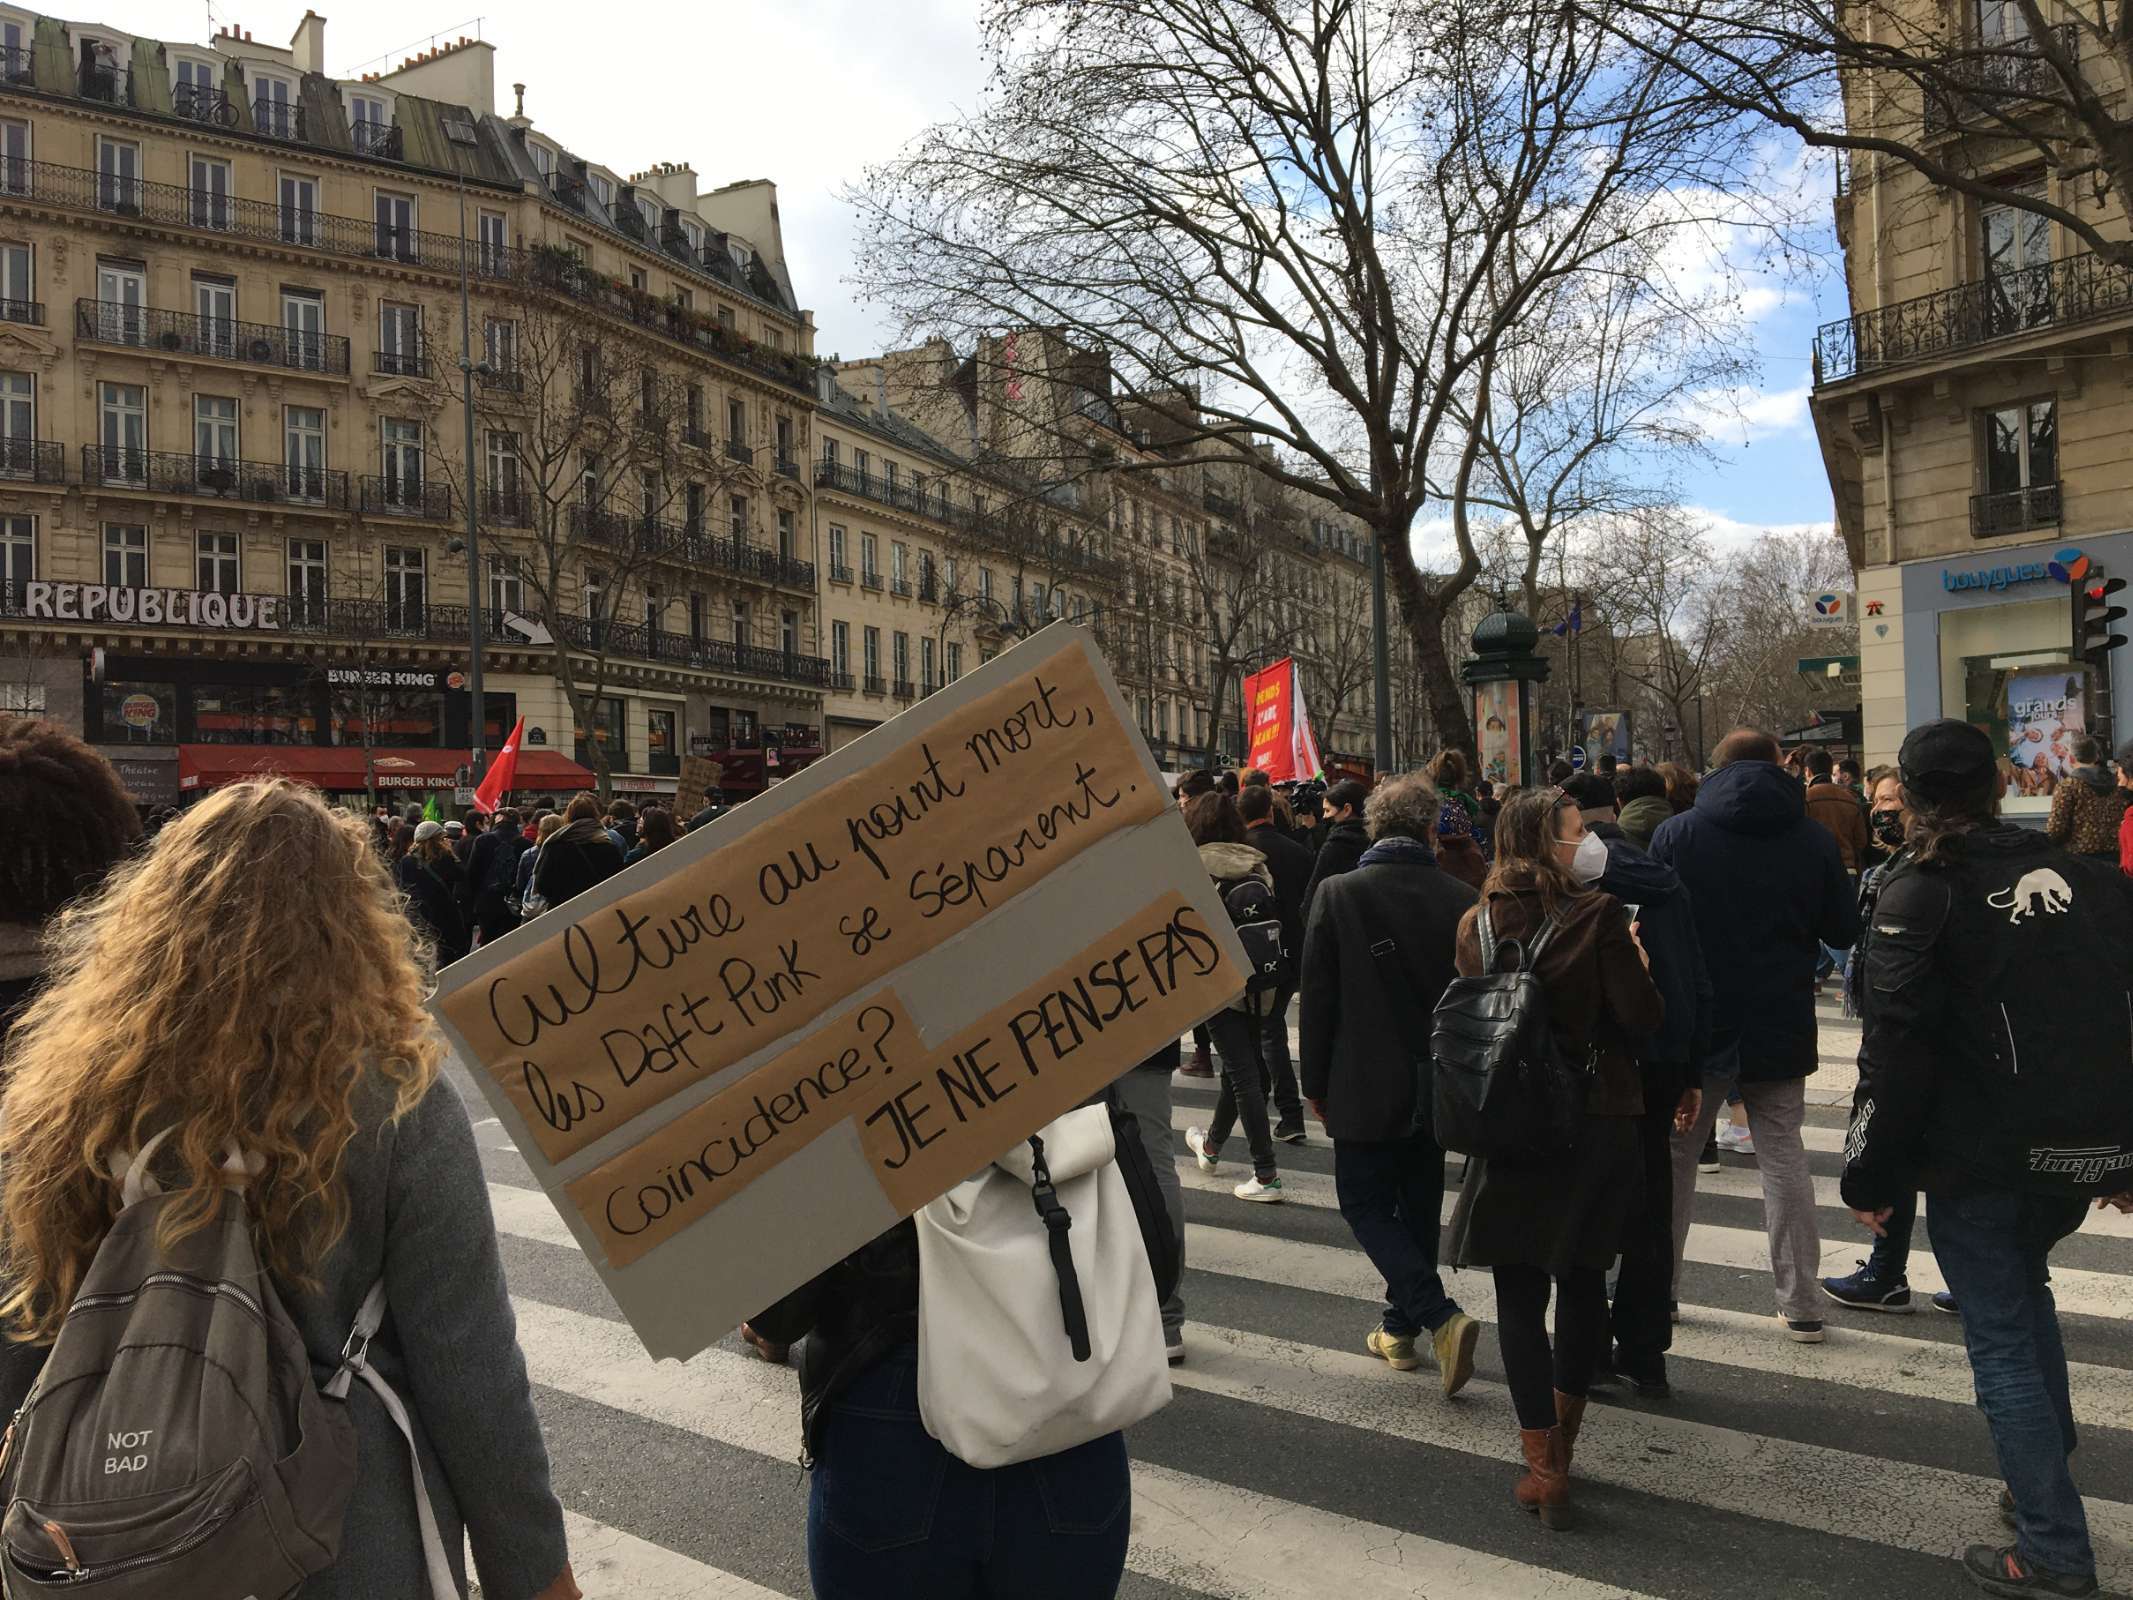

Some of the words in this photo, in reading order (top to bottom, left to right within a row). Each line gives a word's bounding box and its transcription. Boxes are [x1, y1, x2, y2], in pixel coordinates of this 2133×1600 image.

[1942, 562, 2046, 592] bouygues
[26, 581, 280, 629] REPUBLIQUE
[328, 669, 392, 685] BURGER
[395, 672, 435, 687] KING
[2014, 695, 2078, 718] grands
[378, 776, 424, 787] BURGER
[427, 777, 456, 787] KING
[488, 893, 745, 1047] Culture
[759, 842, 841, 906] au
[846, 743, 966, 881] point
[965, 676, 1095, 774] mort,
[523, 1060, 605, 1132] les
[600, 993, 725, 1087] Daft
[718, 940, 822, 1027] Punk
[839, 906, 892, 956] se
[864, 1081, 947, 1169] JE
[936, 1038, 1018, 1122] NE
[1007, 950, 1149, 1077] PENSE
[1137, 906, 1220, 997] PAS
[107, 1430, 154, 1450] NOT
[104, 1454, 148, 1475] BAD
